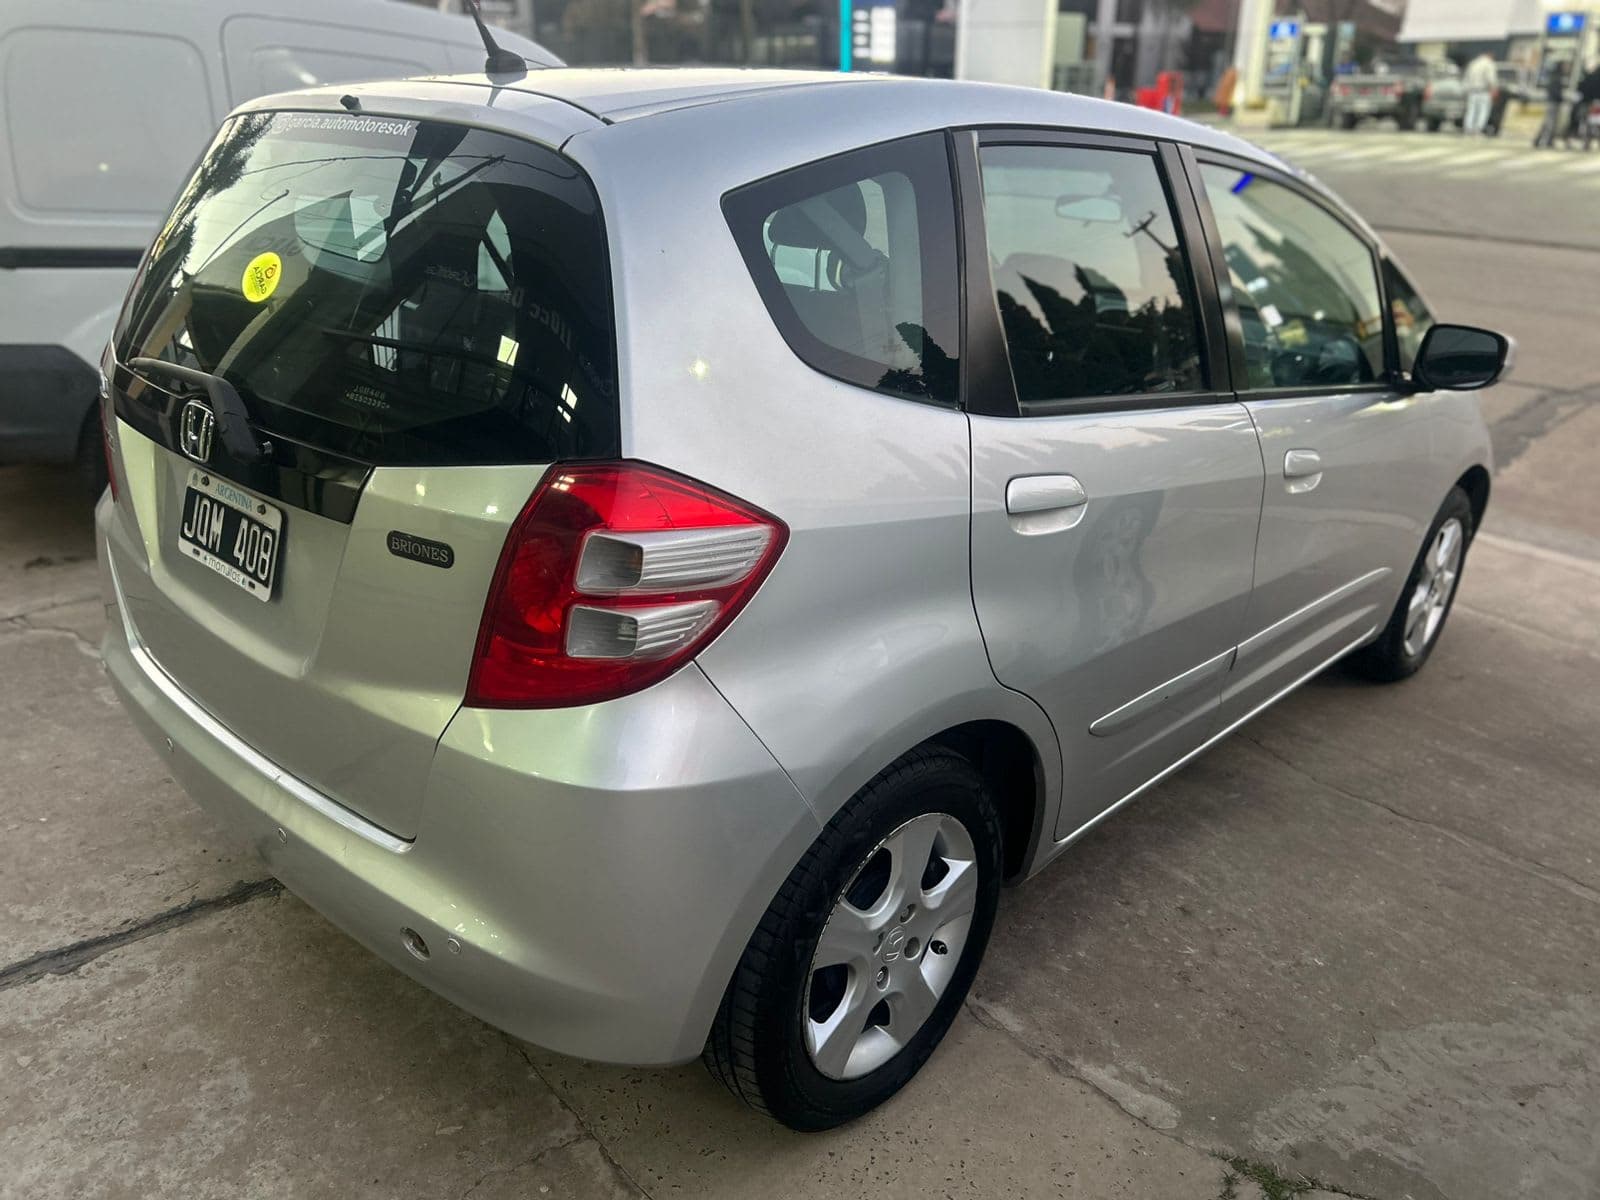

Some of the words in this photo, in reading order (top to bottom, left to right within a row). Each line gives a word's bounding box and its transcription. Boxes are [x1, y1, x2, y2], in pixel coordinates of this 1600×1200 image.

[215, 484, 253, 511] ARGENTINA
[183, 494, 226, 553] JQM
[233, 517, 272, 581] 408
[391, 537, 450, 563] BRIONES
